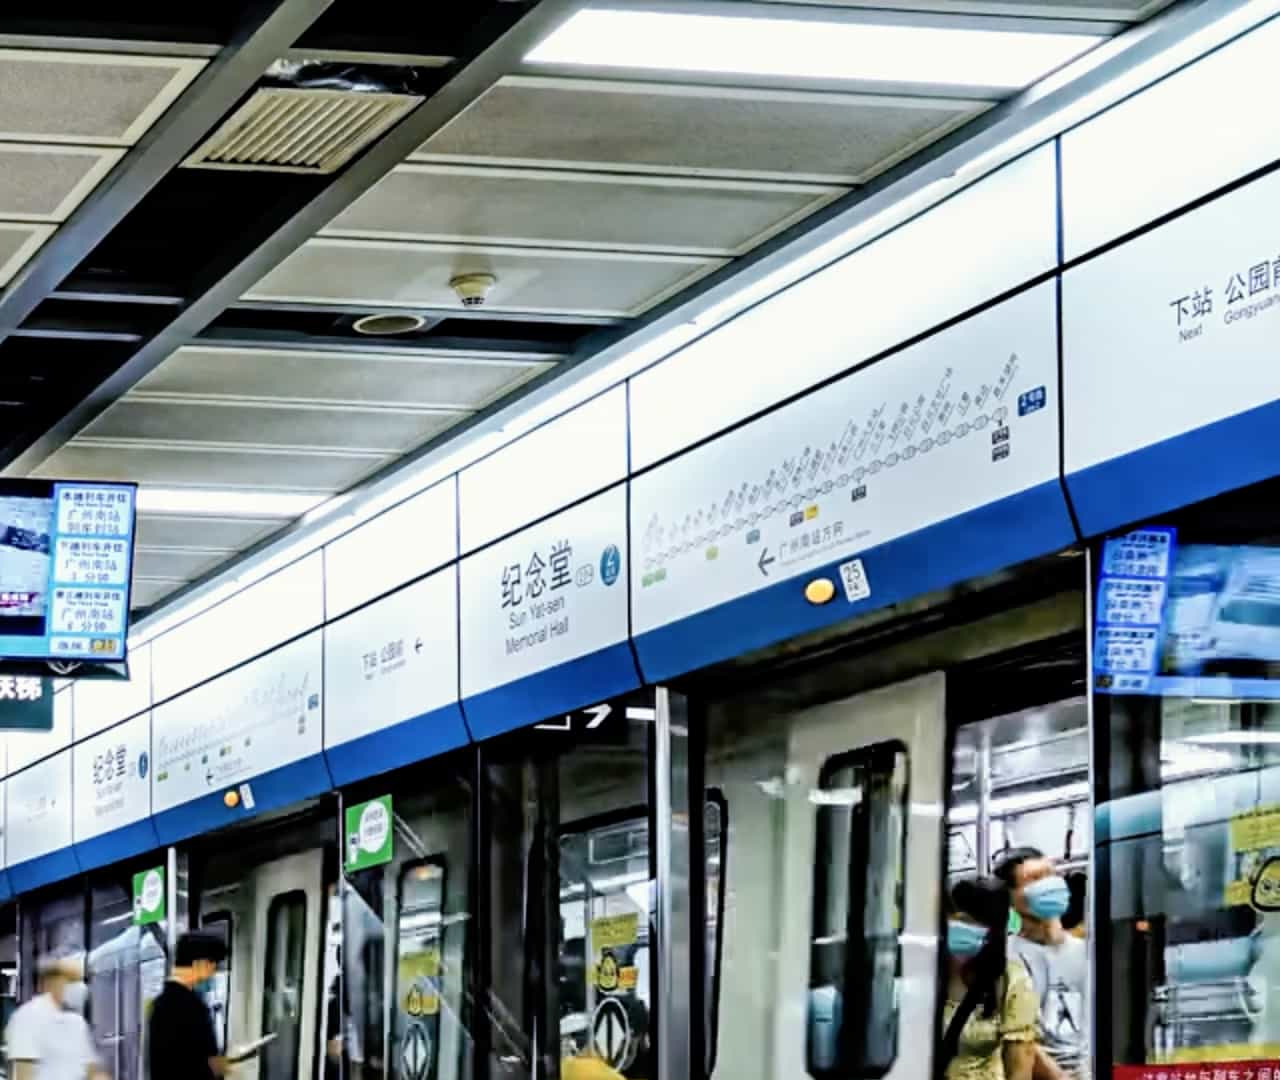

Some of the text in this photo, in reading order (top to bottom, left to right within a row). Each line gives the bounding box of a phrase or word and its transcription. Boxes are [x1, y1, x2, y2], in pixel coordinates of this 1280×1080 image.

[1169, 285, 1213, 326] 下站
[1178, 323, 1203, 343] Next
[501, 539, 573, 608] 纪念堂
